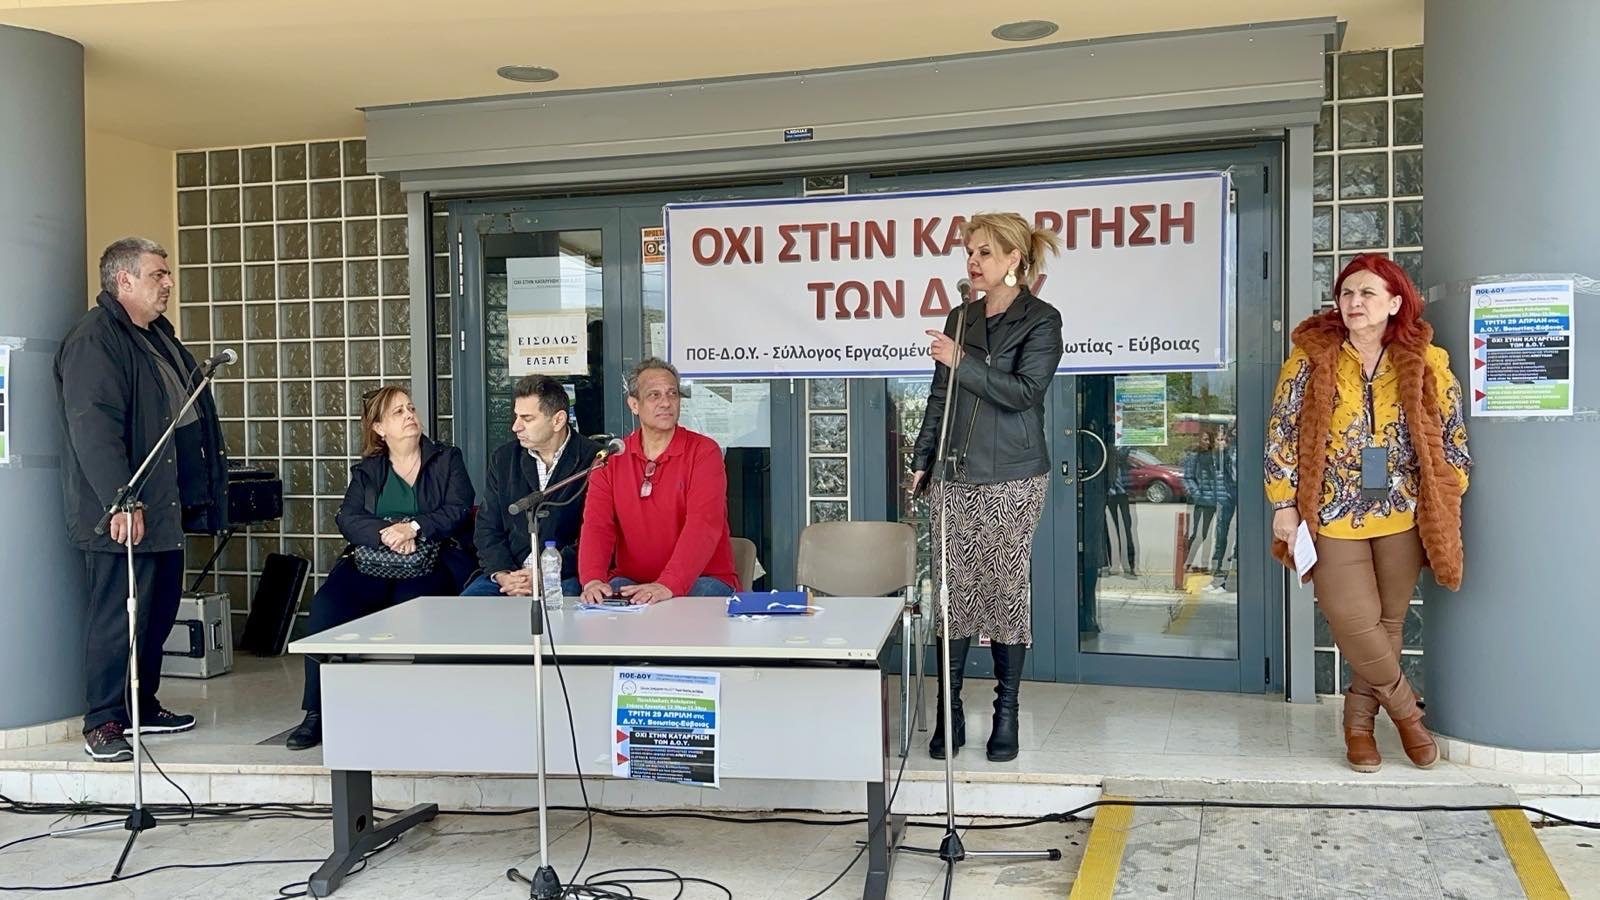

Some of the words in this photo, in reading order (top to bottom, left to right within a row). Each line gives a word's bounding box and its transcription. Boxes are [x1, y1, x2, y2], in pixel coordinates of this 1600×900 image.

[692, 226, 764, 266] ΟΧΙ
[778, 219, 896, 263] ΣΤΗΝ
[913, 201, 1194, 256] ΚΑΡΓΗΣΗ
[807, 279, 905, 320] ΤΩΝ
[686, 347, 759, 360] ΠΟΕ-Δ.Ο.Υ.
[772, 345, 841, 362] Σύλλογος
[845, 342, 932, 361] Εργαζομέν
[1129, 336, 1200, 355] Εύβοιας
[526, 355, 569, 366] ΕΛΞΑΤΕ
[619, 672, 651, 680] ΠΟΕ-ΔΟΥ
[628, 709, 651, 717] ΤΡΙΤΗ
[663, 711, 692, 719] ΑΠΡΙΛΗ
[668, 733, 710, 741] ΚΑΤΑΡΓΗΣΗ
